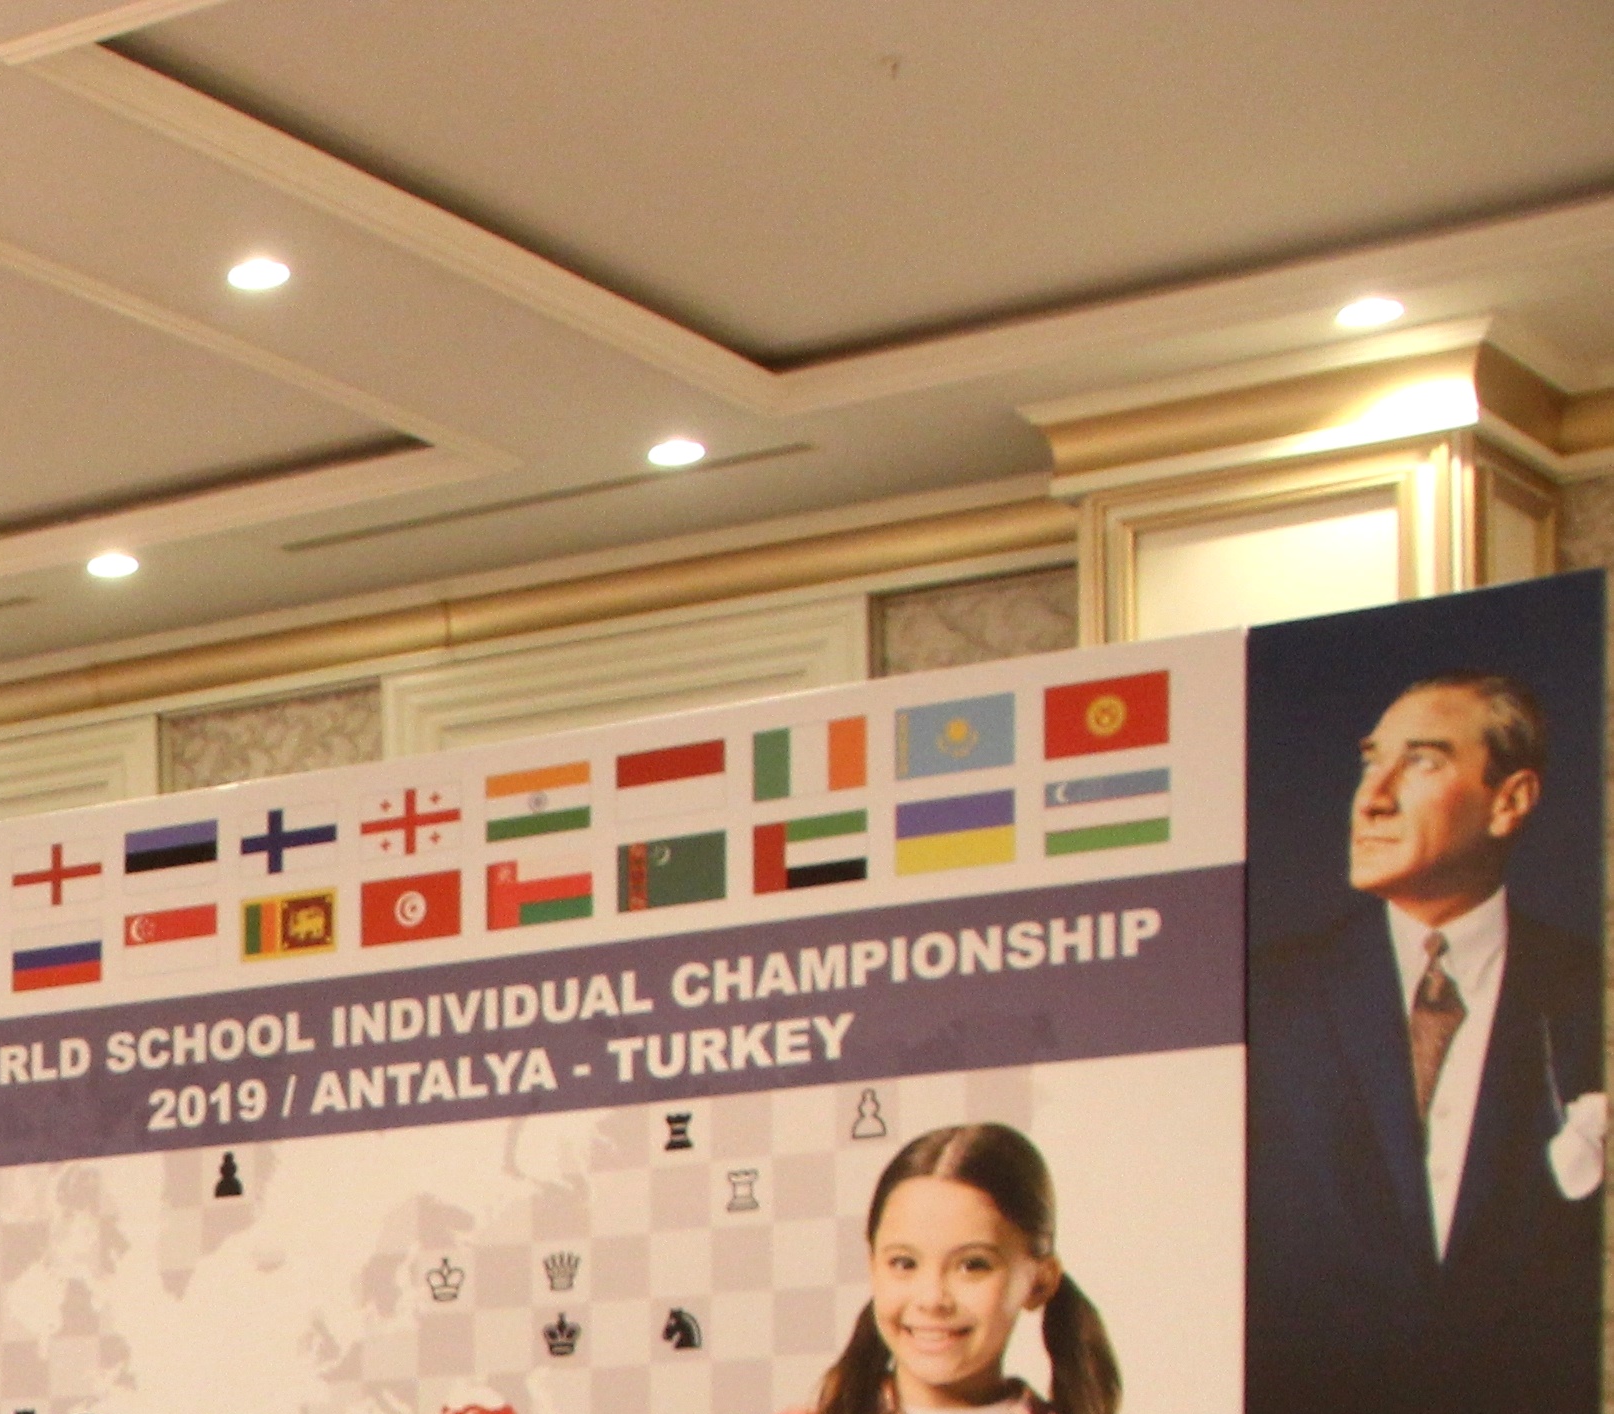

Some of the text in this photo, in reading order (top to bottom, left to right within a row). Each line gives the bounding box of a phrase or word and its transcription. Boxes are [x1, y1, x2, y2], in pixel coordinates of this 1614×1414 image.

[106, 1012, 315, 1074] SCHOOL
[332, 971, 653, 1049] INDIVIDUAL
[672, 908, 1161, 1009] CHAMPIONSHIP
[148, 1075, 267, 1131] 2019
[282, 1075, 297, 1117] /
[311, 1048, 557, 1115] ANTALYA
[608, 1013, 855, 1083] TURKEY
